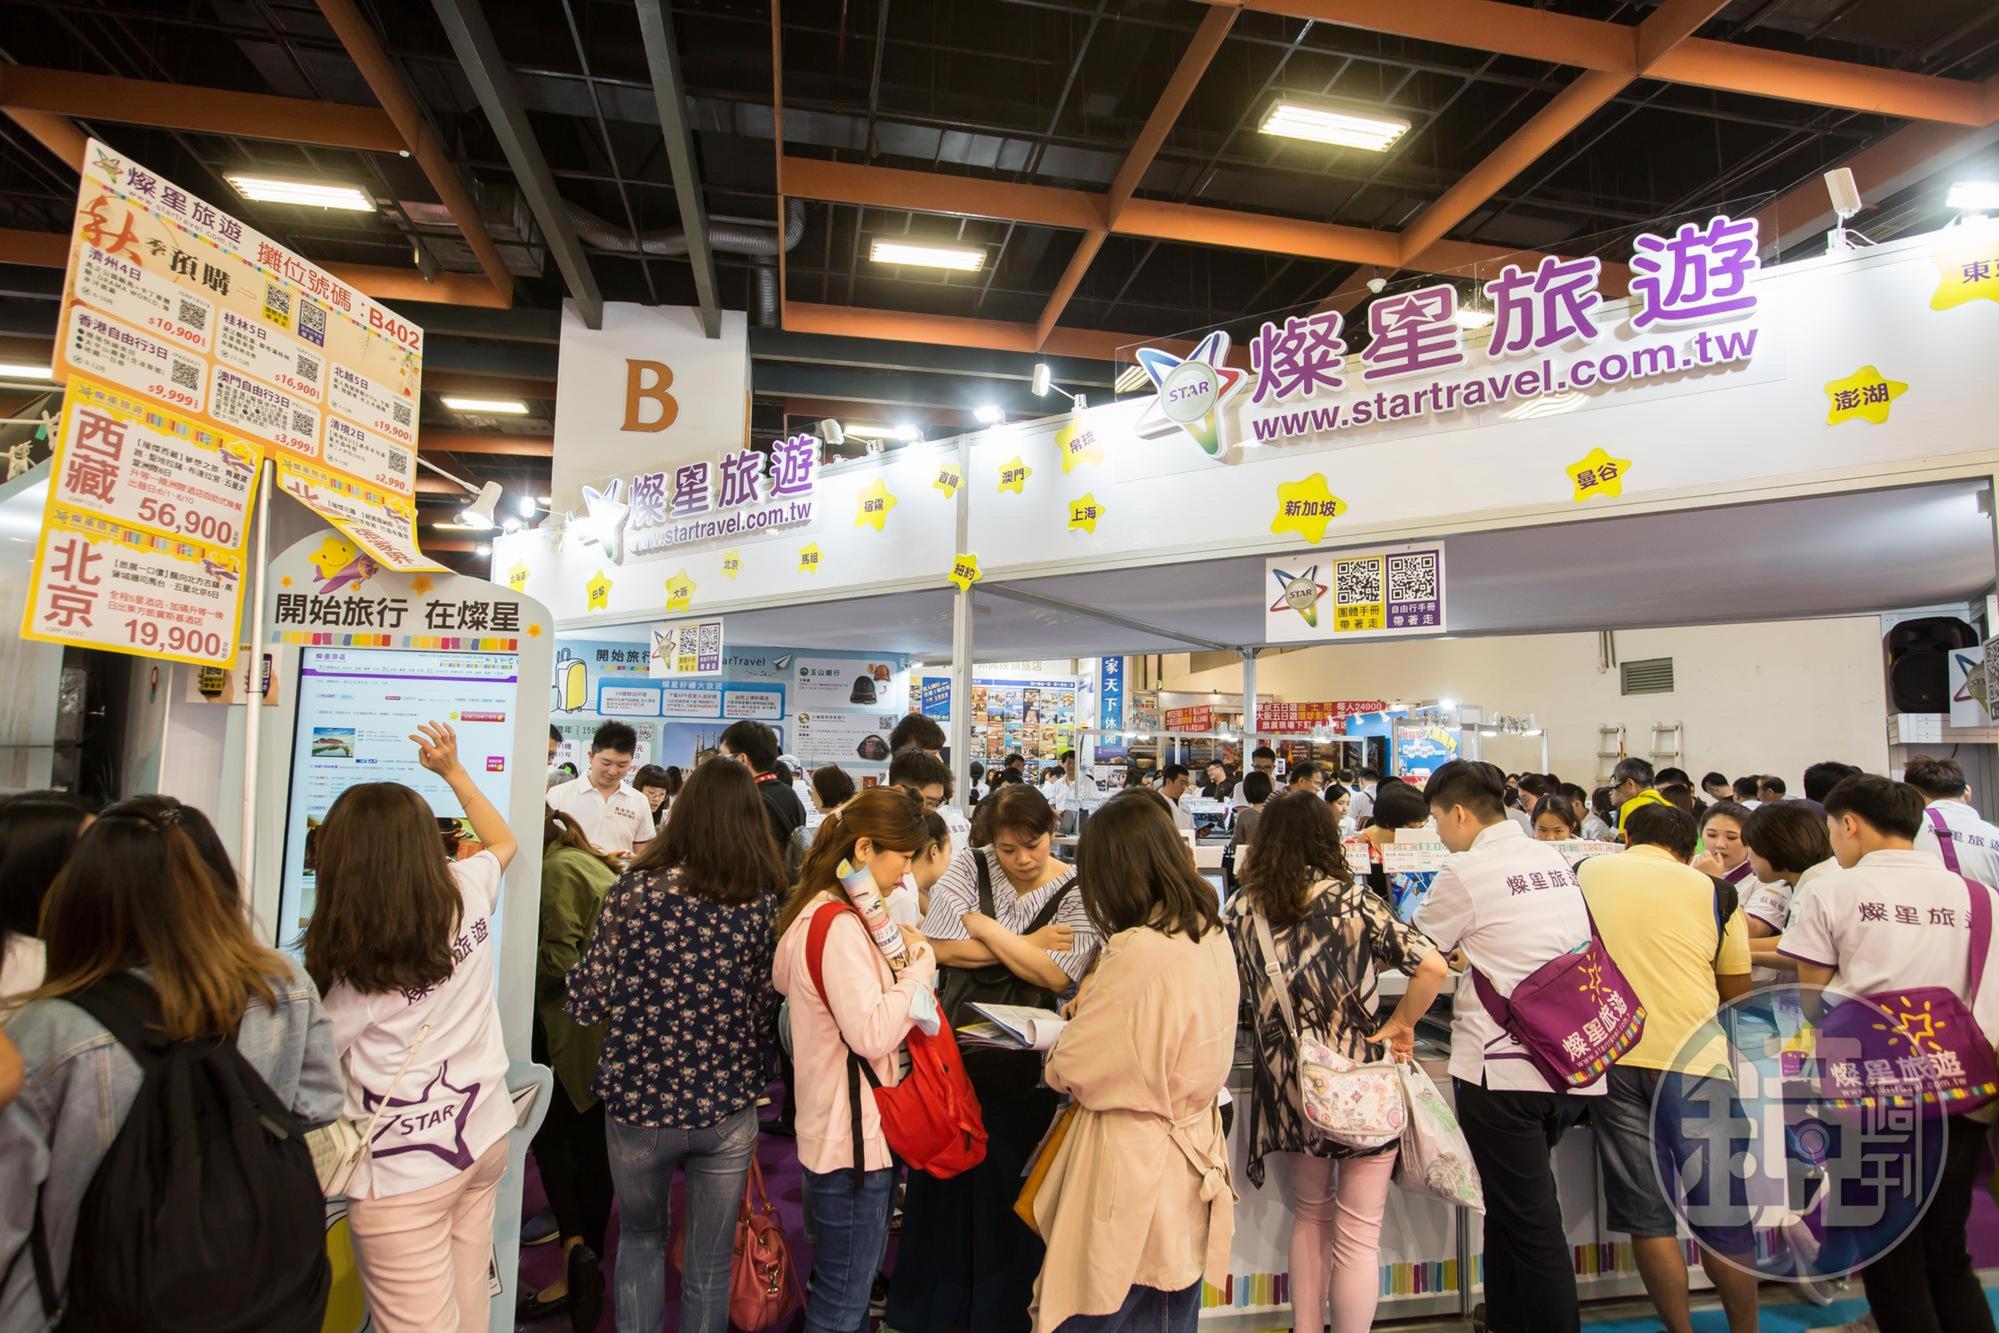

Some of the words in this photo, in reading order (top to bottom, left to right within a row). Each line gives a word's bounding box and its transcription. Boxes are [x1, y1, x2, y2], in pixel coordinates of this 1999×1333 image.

[127, 167, 241, 244] 燦星旅遊
[1961, 258, 1999, 284] 東
[1253, 218, 1760, 404] 燦星旅遊
[79, 314, 168, 360] 香港自由行3日
[148, 317, 202, 345] $10,900
[224, 312, 267, 340] 桂林5日
[217, 369, 290, 408] 澳門自由行3日
[274, 374, 318, 397] $16,900
[334, 366, 369, 390] 北越5日
[1168, 380, 1210, 404] STAR
[1253, 327, 1760, 441] www.startravel.com.tw
[148, 384, 193, 406] $9,999
[620, 358, 679, 432] B
[1834, 382, 1890, 412] 澎湖
[330, 419, 365, 441] 清境2日
[65, 409, 128, 505] 西藏
[629, 435, 814, 524] 燦星旅遊
[1002, 467, 1025, 484] 澳門
[1577, 462, 1619, 491] 曼谷
[864, 497, 885, 513] 宿霧
[1071, 506, 1097, 523] 上海
[1284, 499, 1337, 518] 新加坡
[138, 497, 233, 545] 56,900
[724, 559, 740, 571] 北京
[801, 552, 819, 566] 馬祖
[953, 562, 976, 582] 紐約
[44, 538, 103, 629] 北京
[1288, 587, 1313, 601] STAR
[275, 593, 408, 629] 開始旅行
[425, 599, 520, 632] 在燦星
[1337, 605, 1380, 618] 團體手冊
[1391, 602, 1436, 614] 自由行手冊
[1393, 614, 1434, 627] 帶著走
[124, 618, 221, 657] 19,900
[1340, 618, 1378, 630] 帶著走
[1858, 900, 1972, 928] 燦星旅
[1562, 990, 1628, 1062] 燦星旅遊
[1830, 1050, 1967, 1089] 燦星旅遊
[400, 1103, 456, 1137] STAR
